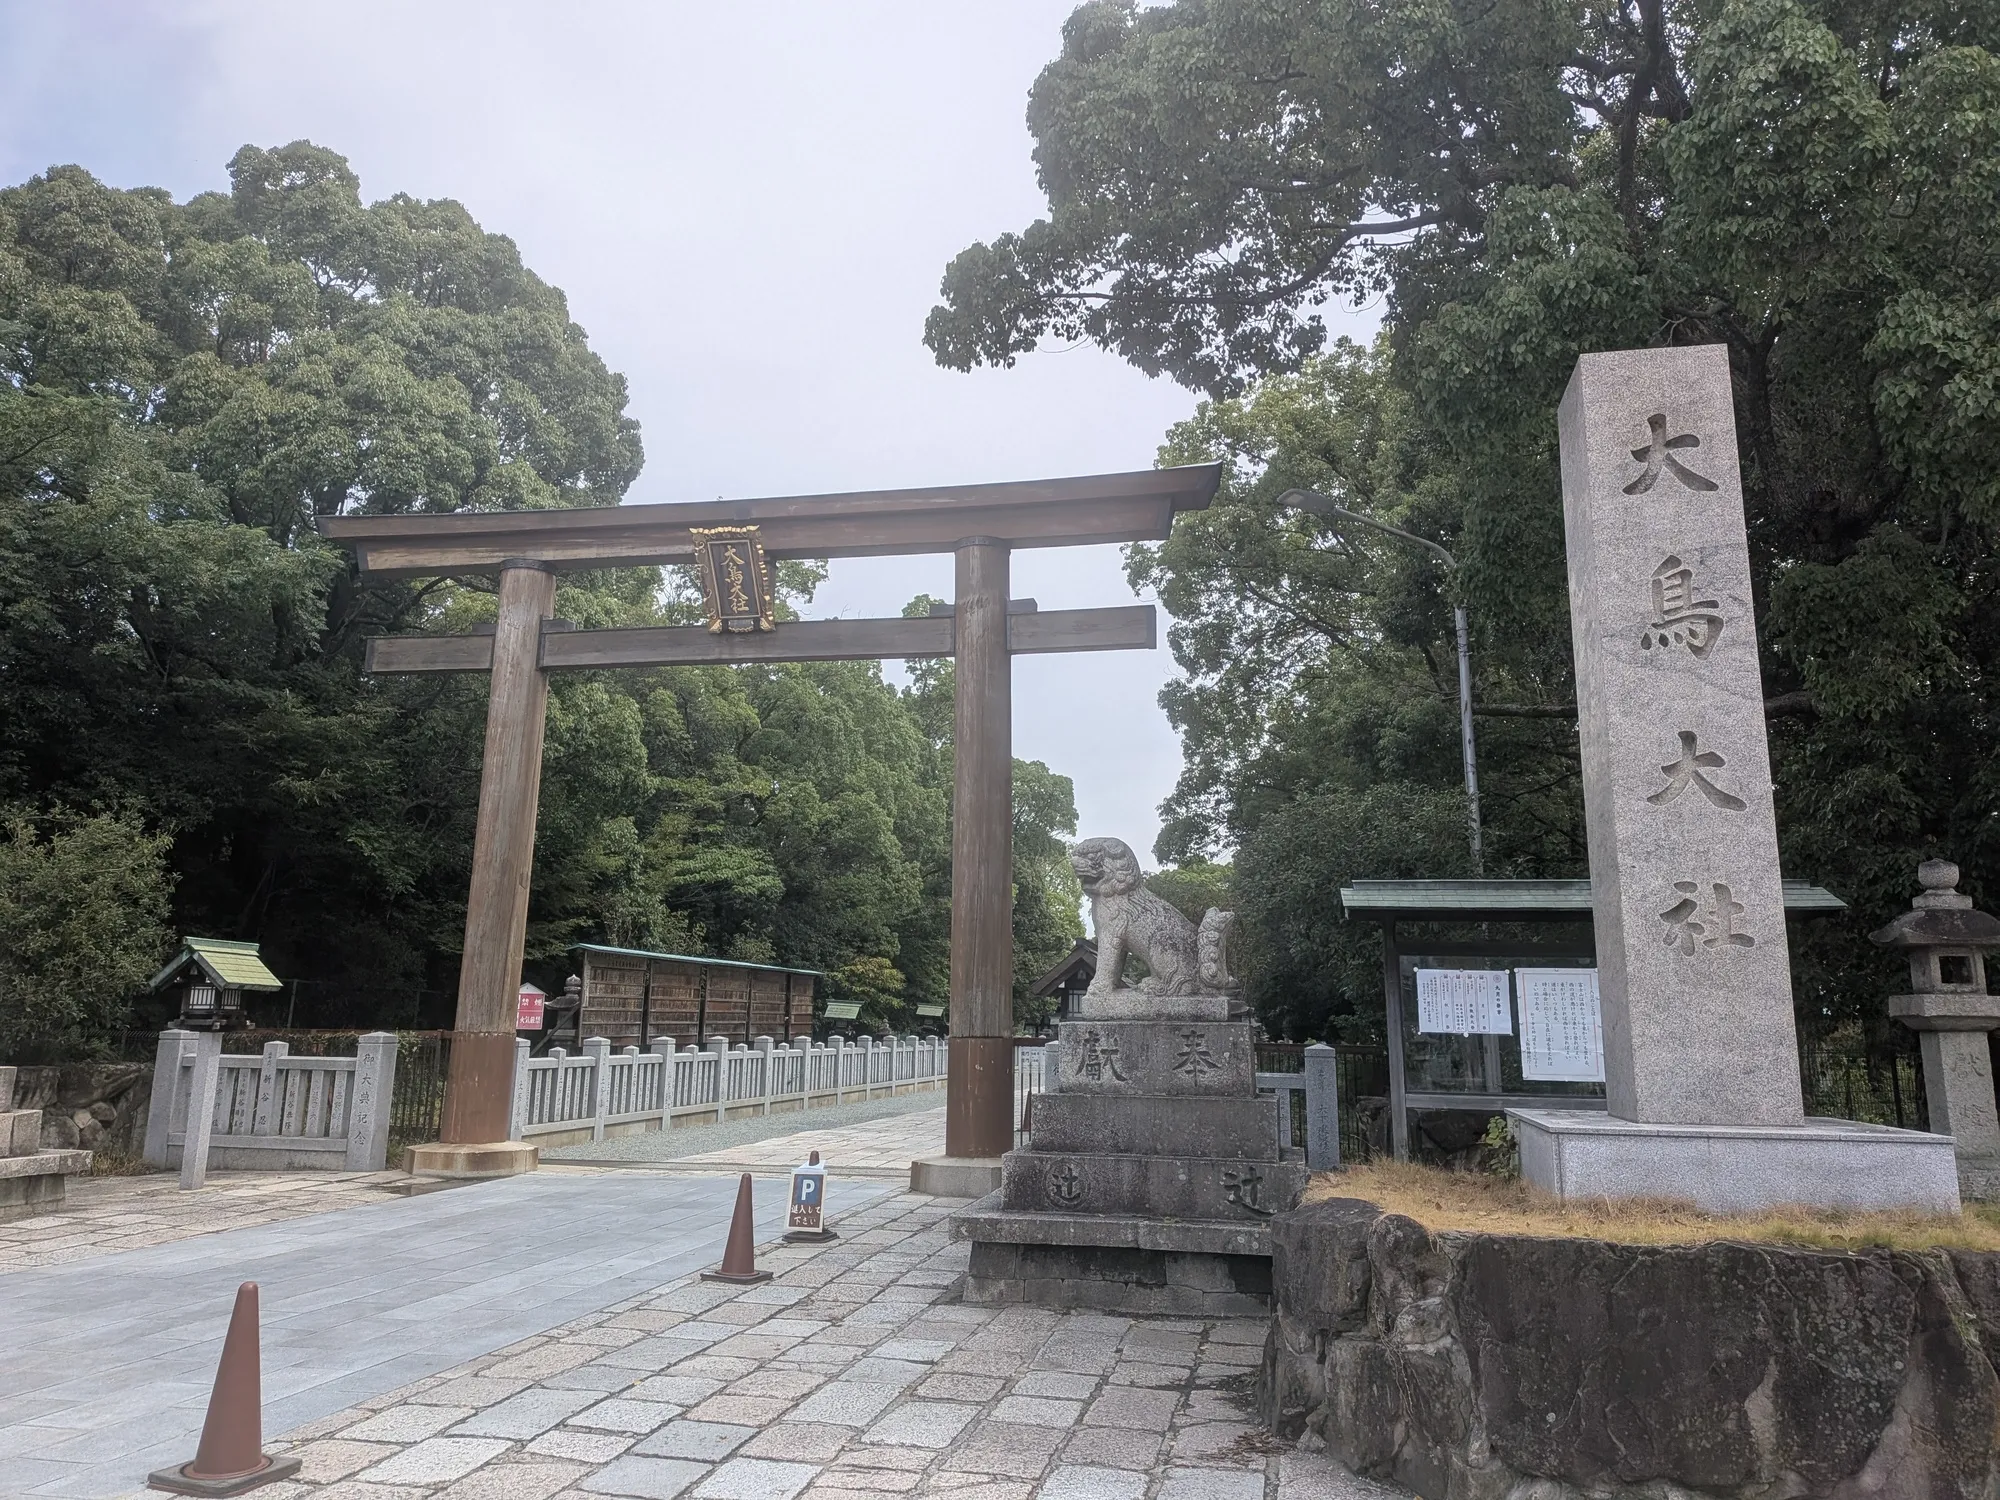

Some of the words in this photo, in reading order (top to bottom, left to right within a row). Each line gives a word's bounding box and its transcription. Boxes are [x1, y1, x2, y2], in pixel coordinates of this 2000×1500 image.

[720, 545, 750, 614] 大鳥大社
[1622, 412, 1755, 957] 大鳥大社
[353, 1053, 375, 1145] 御大典記念
[793, 1216, 816, 1226] 下さい
[801, 1179, 816, 1201] P
